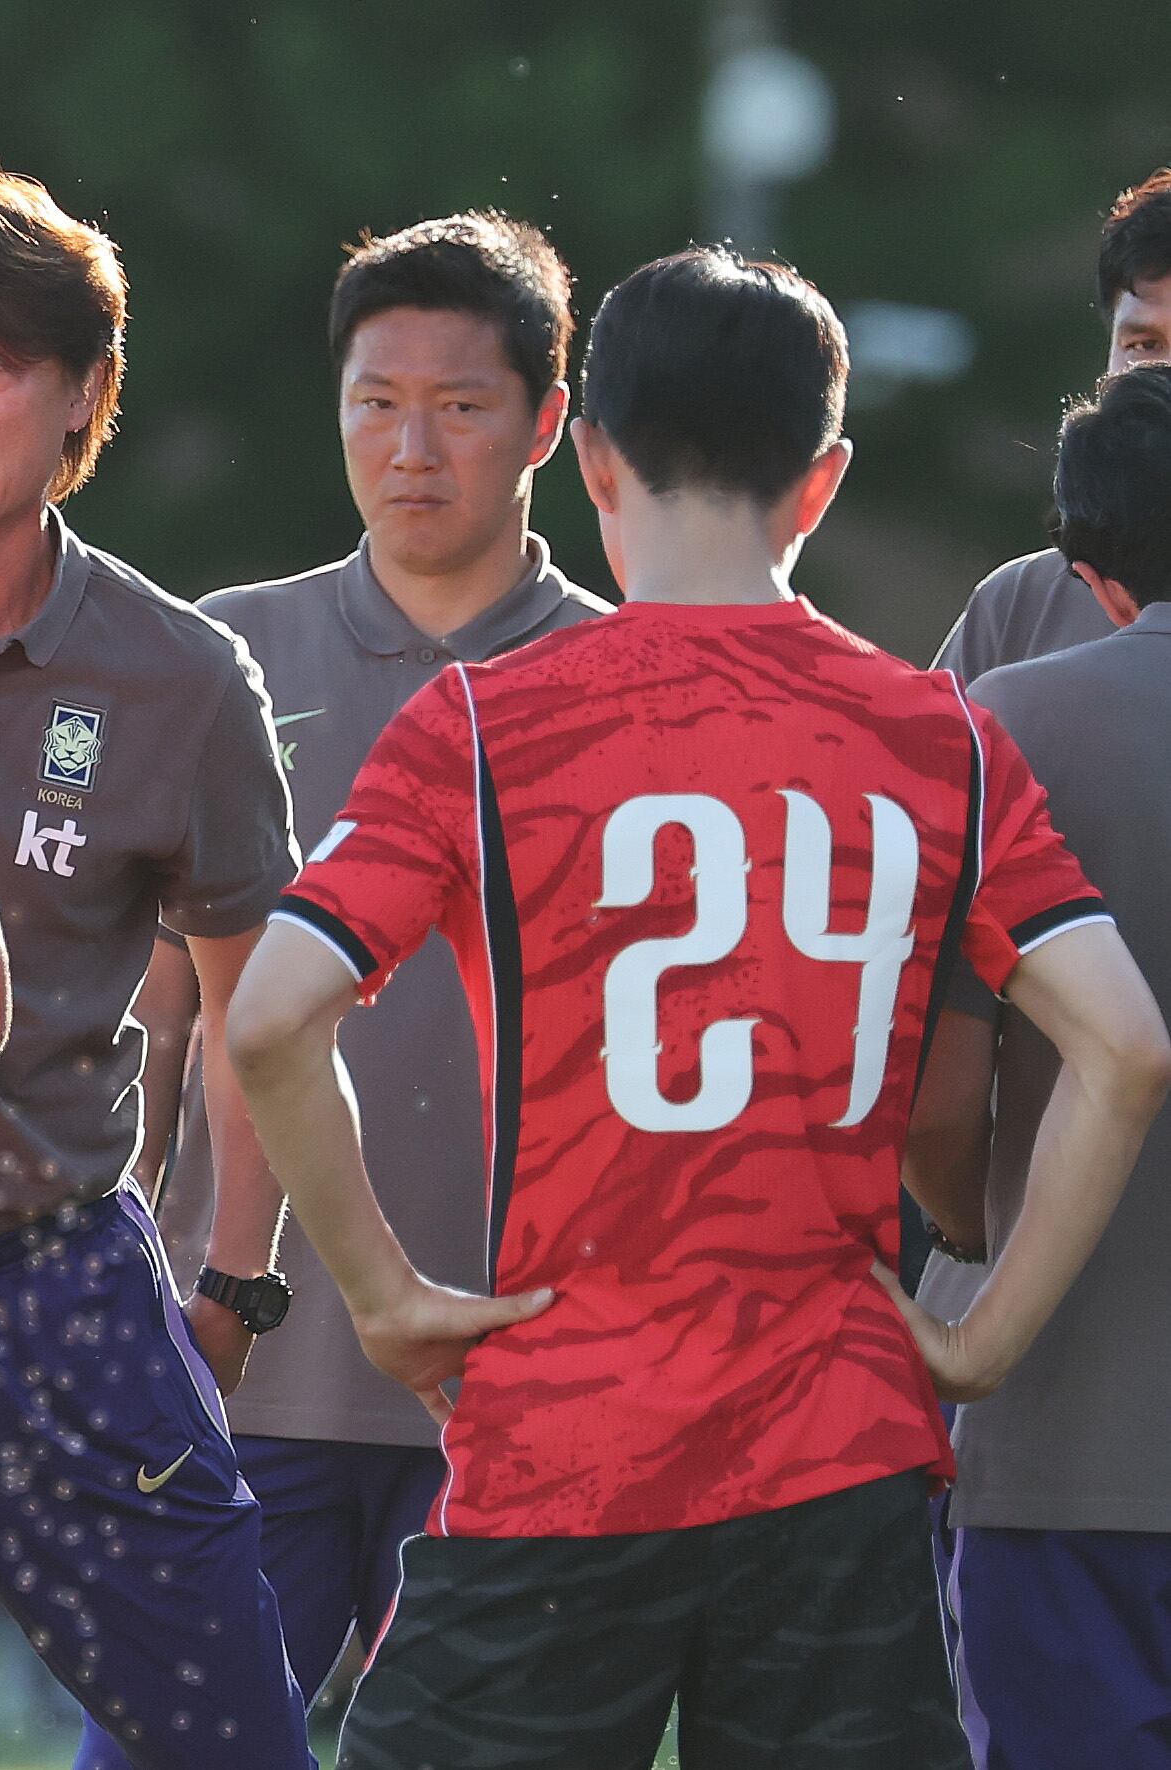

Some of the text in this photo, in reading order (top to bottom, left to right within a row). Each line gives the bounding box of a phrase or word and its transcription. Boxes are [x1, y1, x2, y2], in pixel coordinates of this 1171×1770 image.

[37, 787, 83, 811] KOREA
[14, 809, 87, 878] kt
[594, 789, 919, 1133] 24
